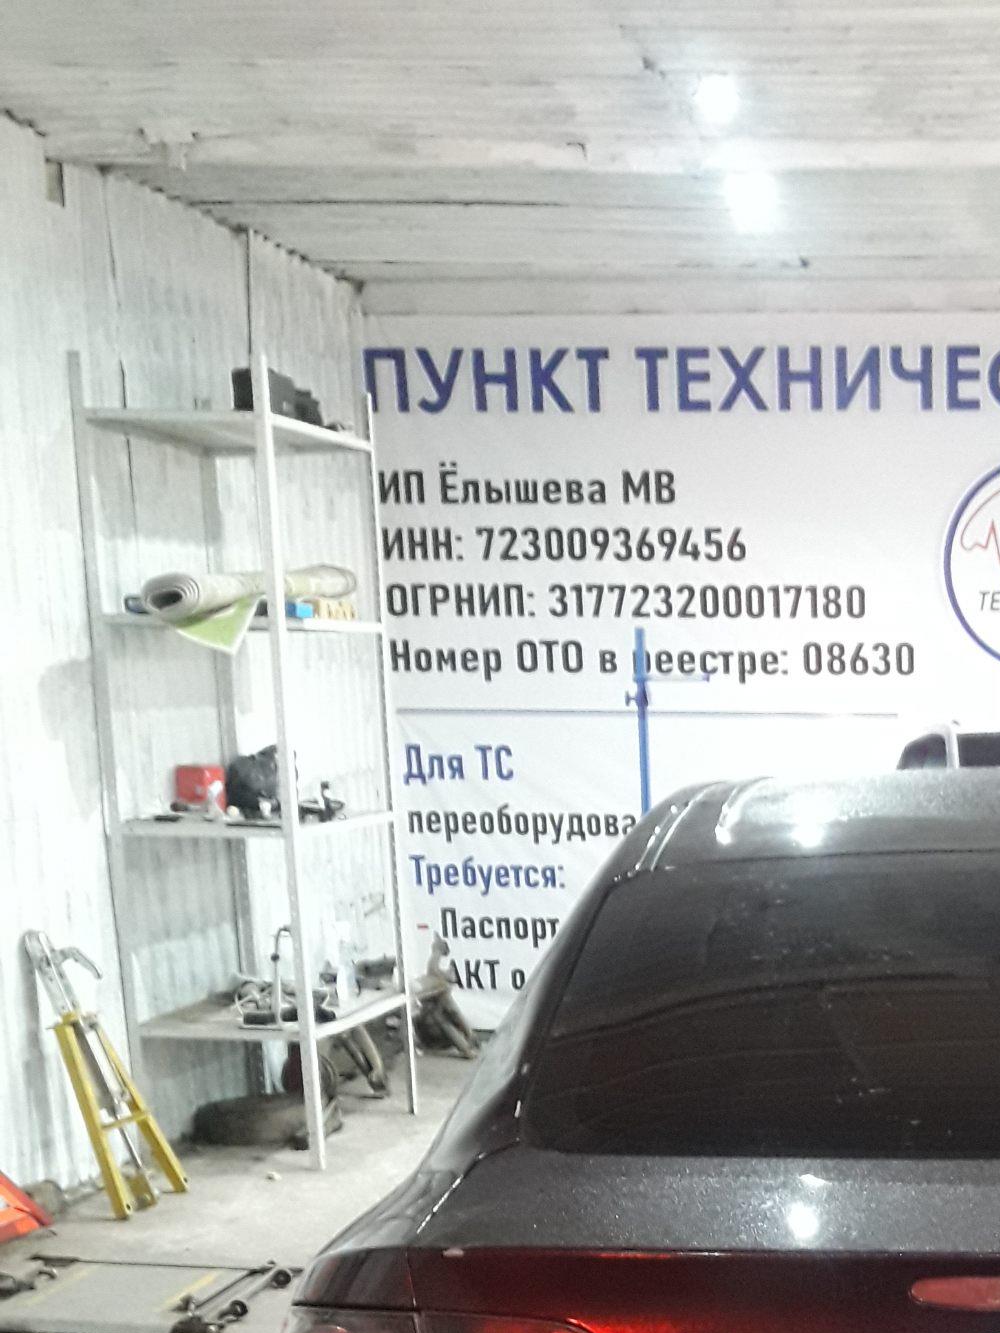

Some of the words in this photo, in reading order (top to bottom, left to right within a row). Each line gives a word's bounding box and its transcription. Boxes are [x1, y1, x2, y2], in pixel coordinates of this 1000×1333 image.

[363, 346, 609, 413] ПУНКТ
[378, 469, 425, 504] ИП
[438, 461, 606, 505] Ёлышева
[621, 470, 676, 504] МВ
[381, 527, 465, 562] ИНН:
[475, 527, 747, 562] 723009369456
[386, 583, 536, 619] ОГРНИП:
[548, 584, 866, 619] 317723200017180
[390, 639, 502, 683] Номер
[517, 641, 583, 673] ОТО
[600, 650, 618, 674] в
[803, 642, 916, 676] 08630
[403, 744, 464, 785] Для
[474, 745, 514, 781] ТС
[408, 803, 636, 845] переоборудова
[409, 854, 566, 895] Требуется:
[440, 906, 560, 948] Паспорт
